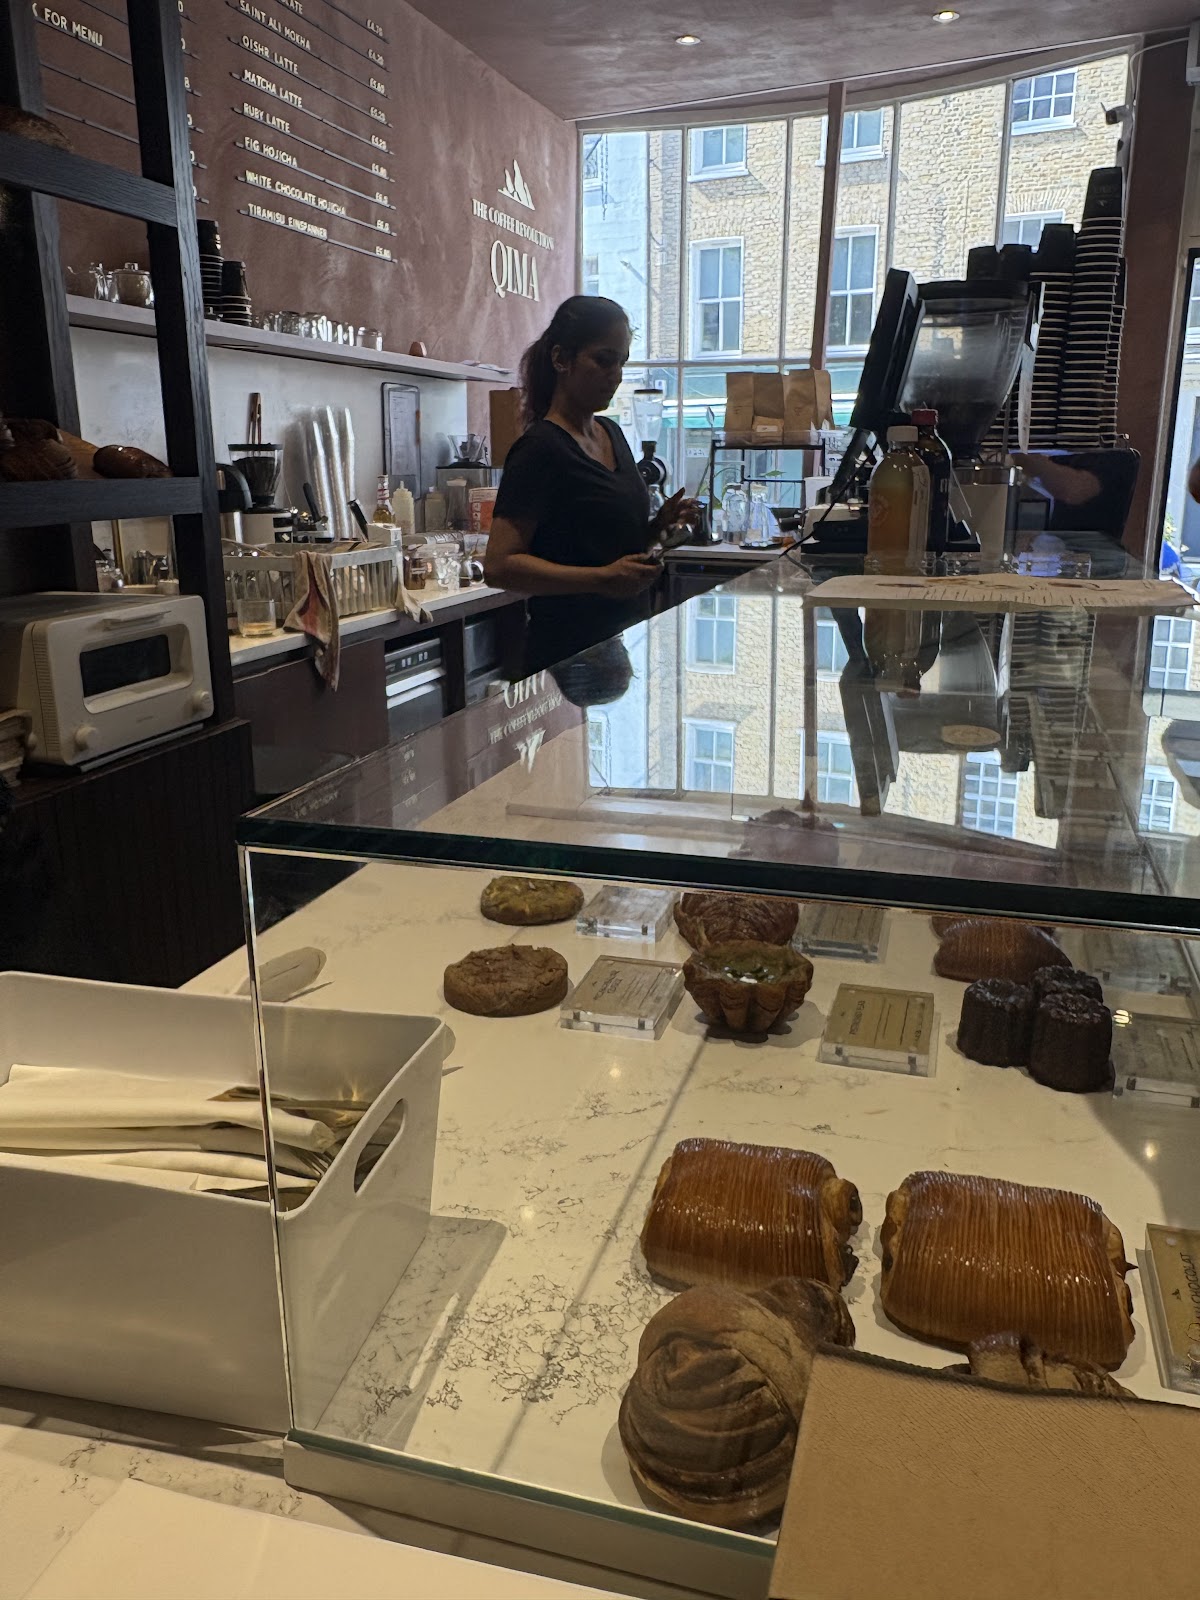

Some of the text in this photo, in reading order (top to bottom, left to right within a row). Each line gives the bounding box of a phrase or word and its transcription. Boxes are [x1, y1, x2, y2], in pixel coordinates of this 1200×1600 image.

[44, 7, 68, 31] FOR
[72, 21, 104, 47] MENU
[240, 0, 266, 24] SAINT
[268, 17, 282, 33] ALI
[284, 26, 311, 51] MOKHA
[242, 35, 270, 58] QISHR
[274, 52, 299, 75] LATTE
[244, 69, 276, 94] MATCHA
[279, 87, 303, 109] LATTE
[243, 102, 264, 120] RUBY
[266, 112, 291, 134] LATTE
[244, 136, 260, 151] FIG
[245, 169, 272, 189] WHITE
[274, 181, 316, 206] CHOCOLATE
[248, 203, 286, 225] TIRAMISU
[472, 198, 488, 221] THE
[488, 206, 515, 233] COFFEE
[490, 239, 540, 302] QIMA
